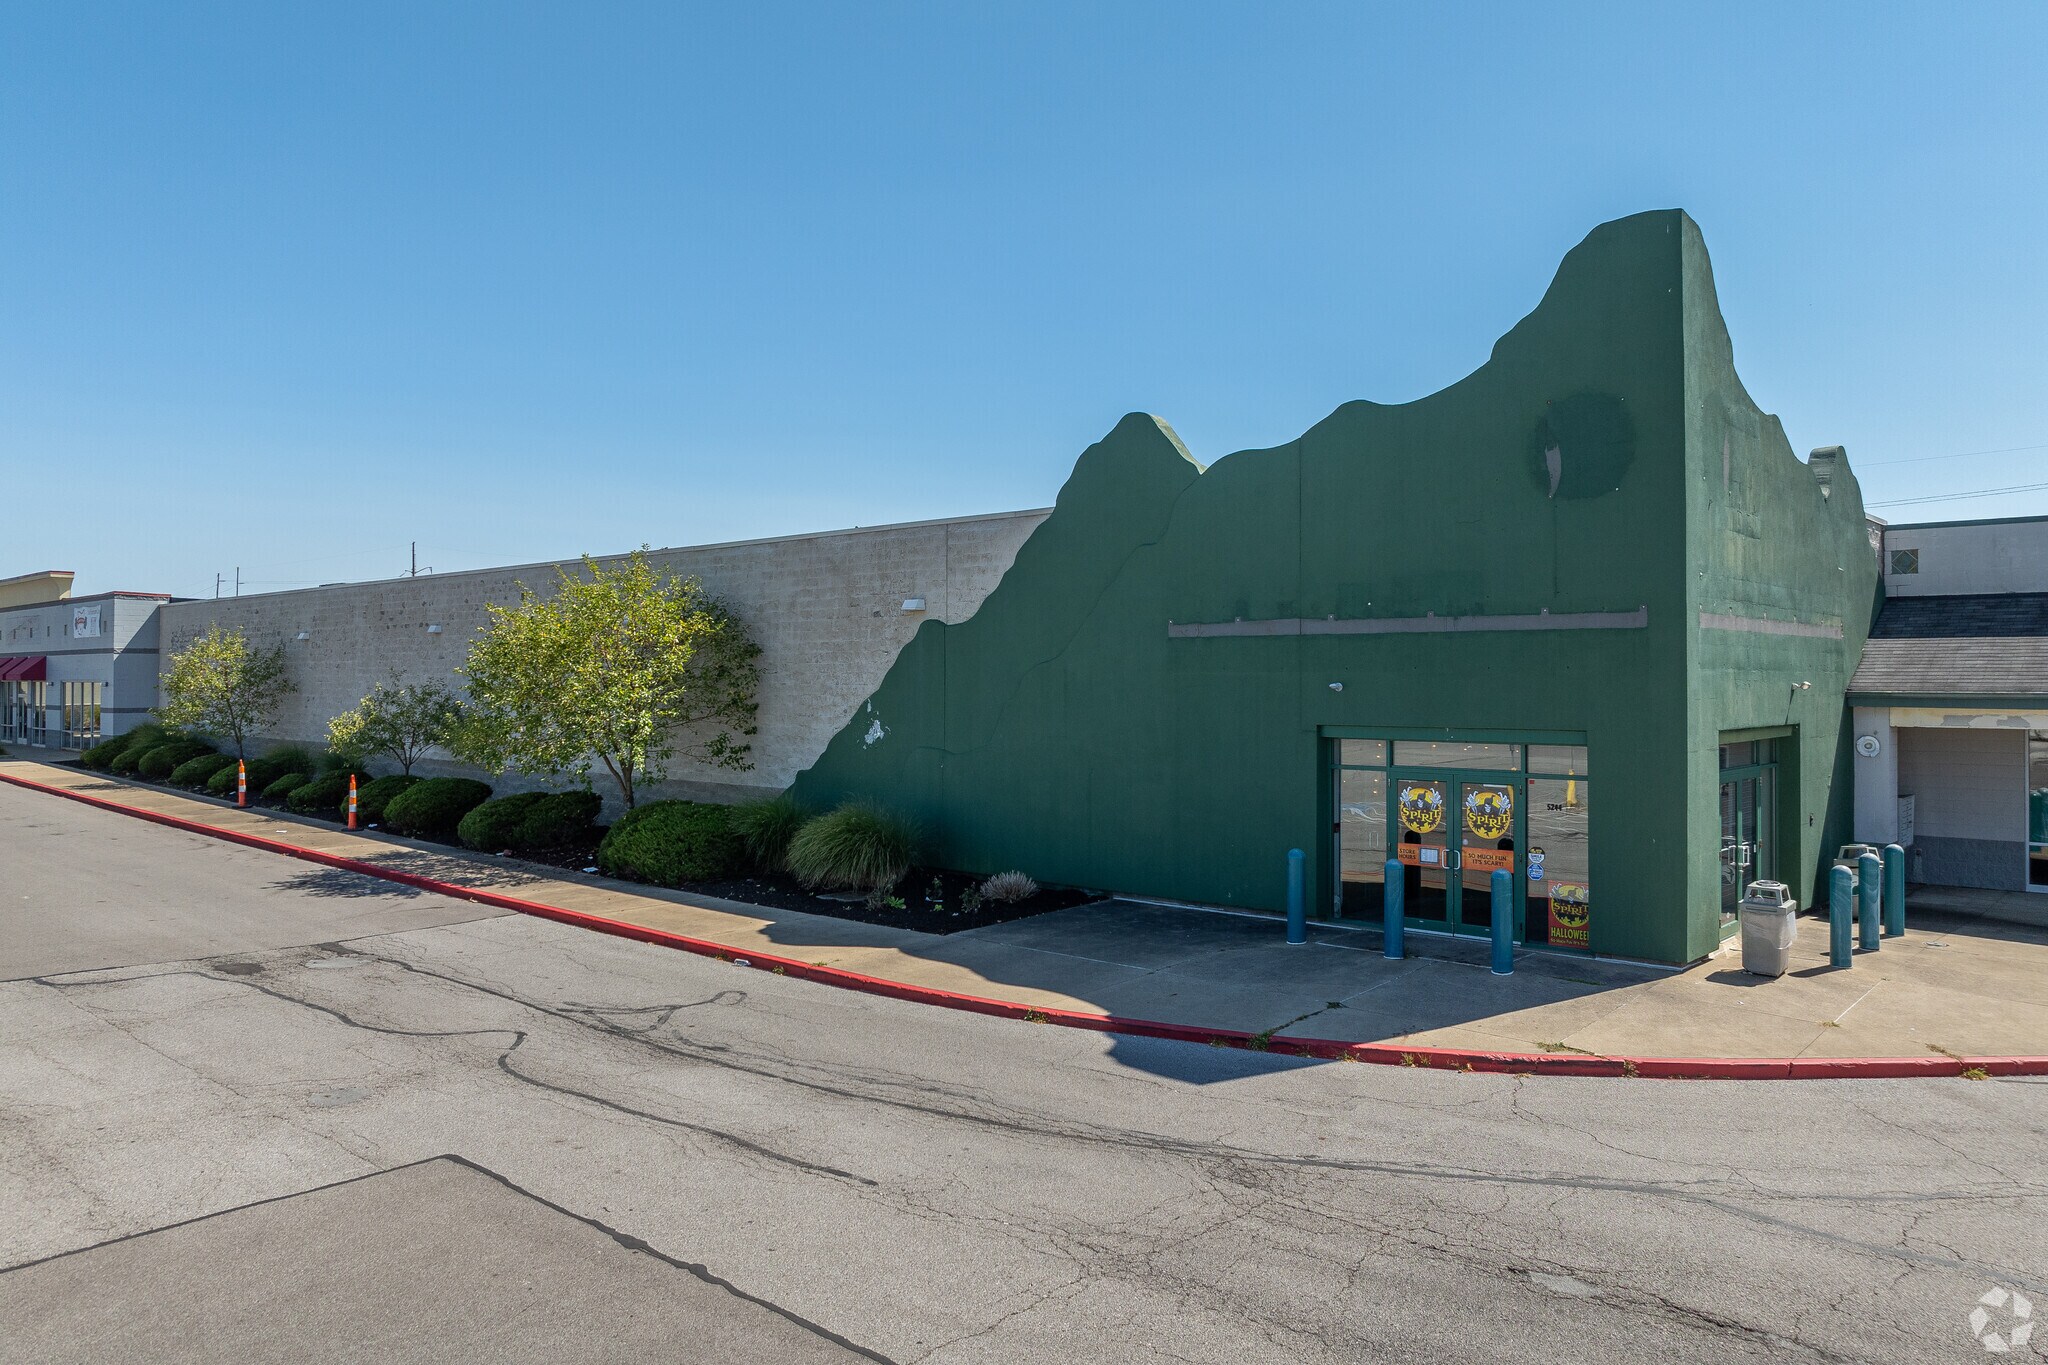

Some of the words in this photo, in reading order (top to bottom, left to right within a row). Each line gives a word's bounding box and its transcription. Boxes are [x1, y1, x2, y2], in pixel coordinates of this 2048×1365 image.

[1403, 807, 1440, 822] SPIRIT
[1468, 812, 1508, 828] SPIRIT
[1554, 902, 1589, 915] SPIRIT
